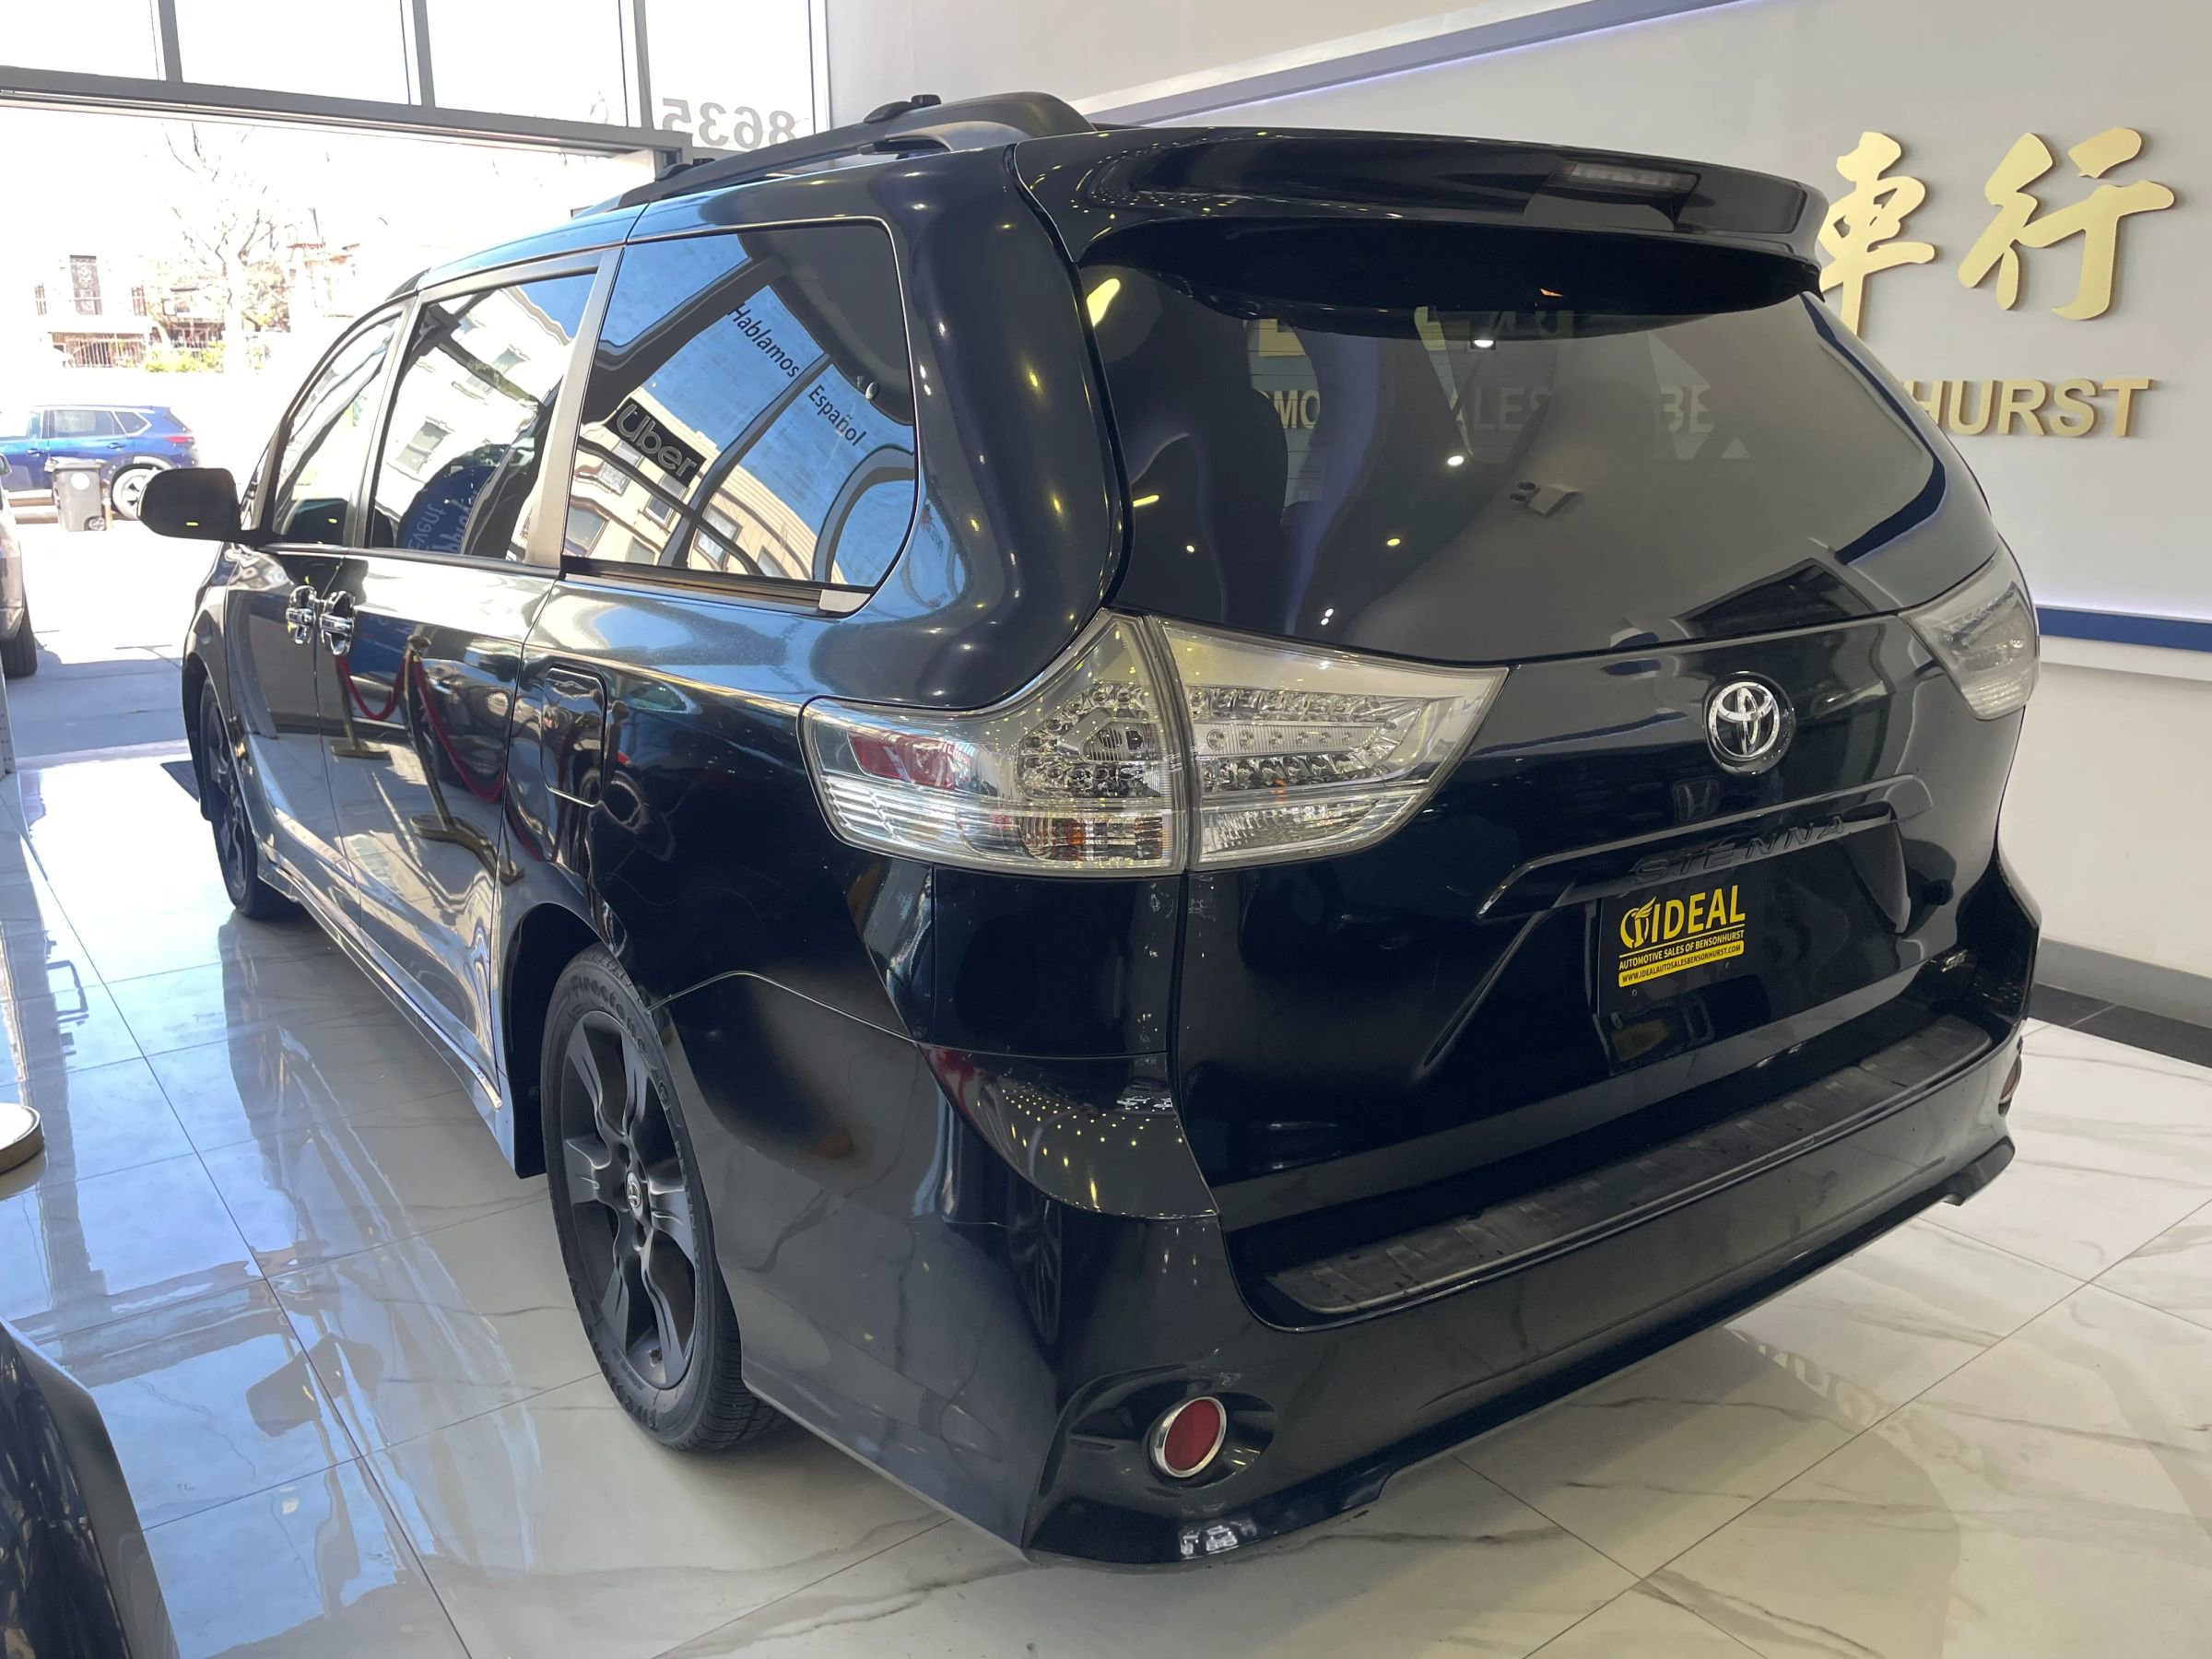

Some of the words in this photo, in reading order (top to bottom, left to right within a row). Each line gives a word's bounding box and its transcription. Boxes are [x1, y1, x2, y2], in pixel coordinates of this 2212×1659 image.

[1818, 127, 2175, 339] 車行
[728, 303, 800, 378] Hablamos
[807, 384, 867, 447] Español
[616, 403, 698, 477] Uber
[1631, 813, 1844, 884] SIENNA
[1651, 884, 1746, 944] IDEAL
[1618, 950, 1663, 971] AUTOMOTIVE
[1664, 945, 1684, 959] SALES
[1685, 943, 1694, 953] OF
[1695, 929, 1745, 950] BENSONHURST
[1621, 945, 1741, 982] WWW.IDEALAUTOSALESBENSONHURST.COM
